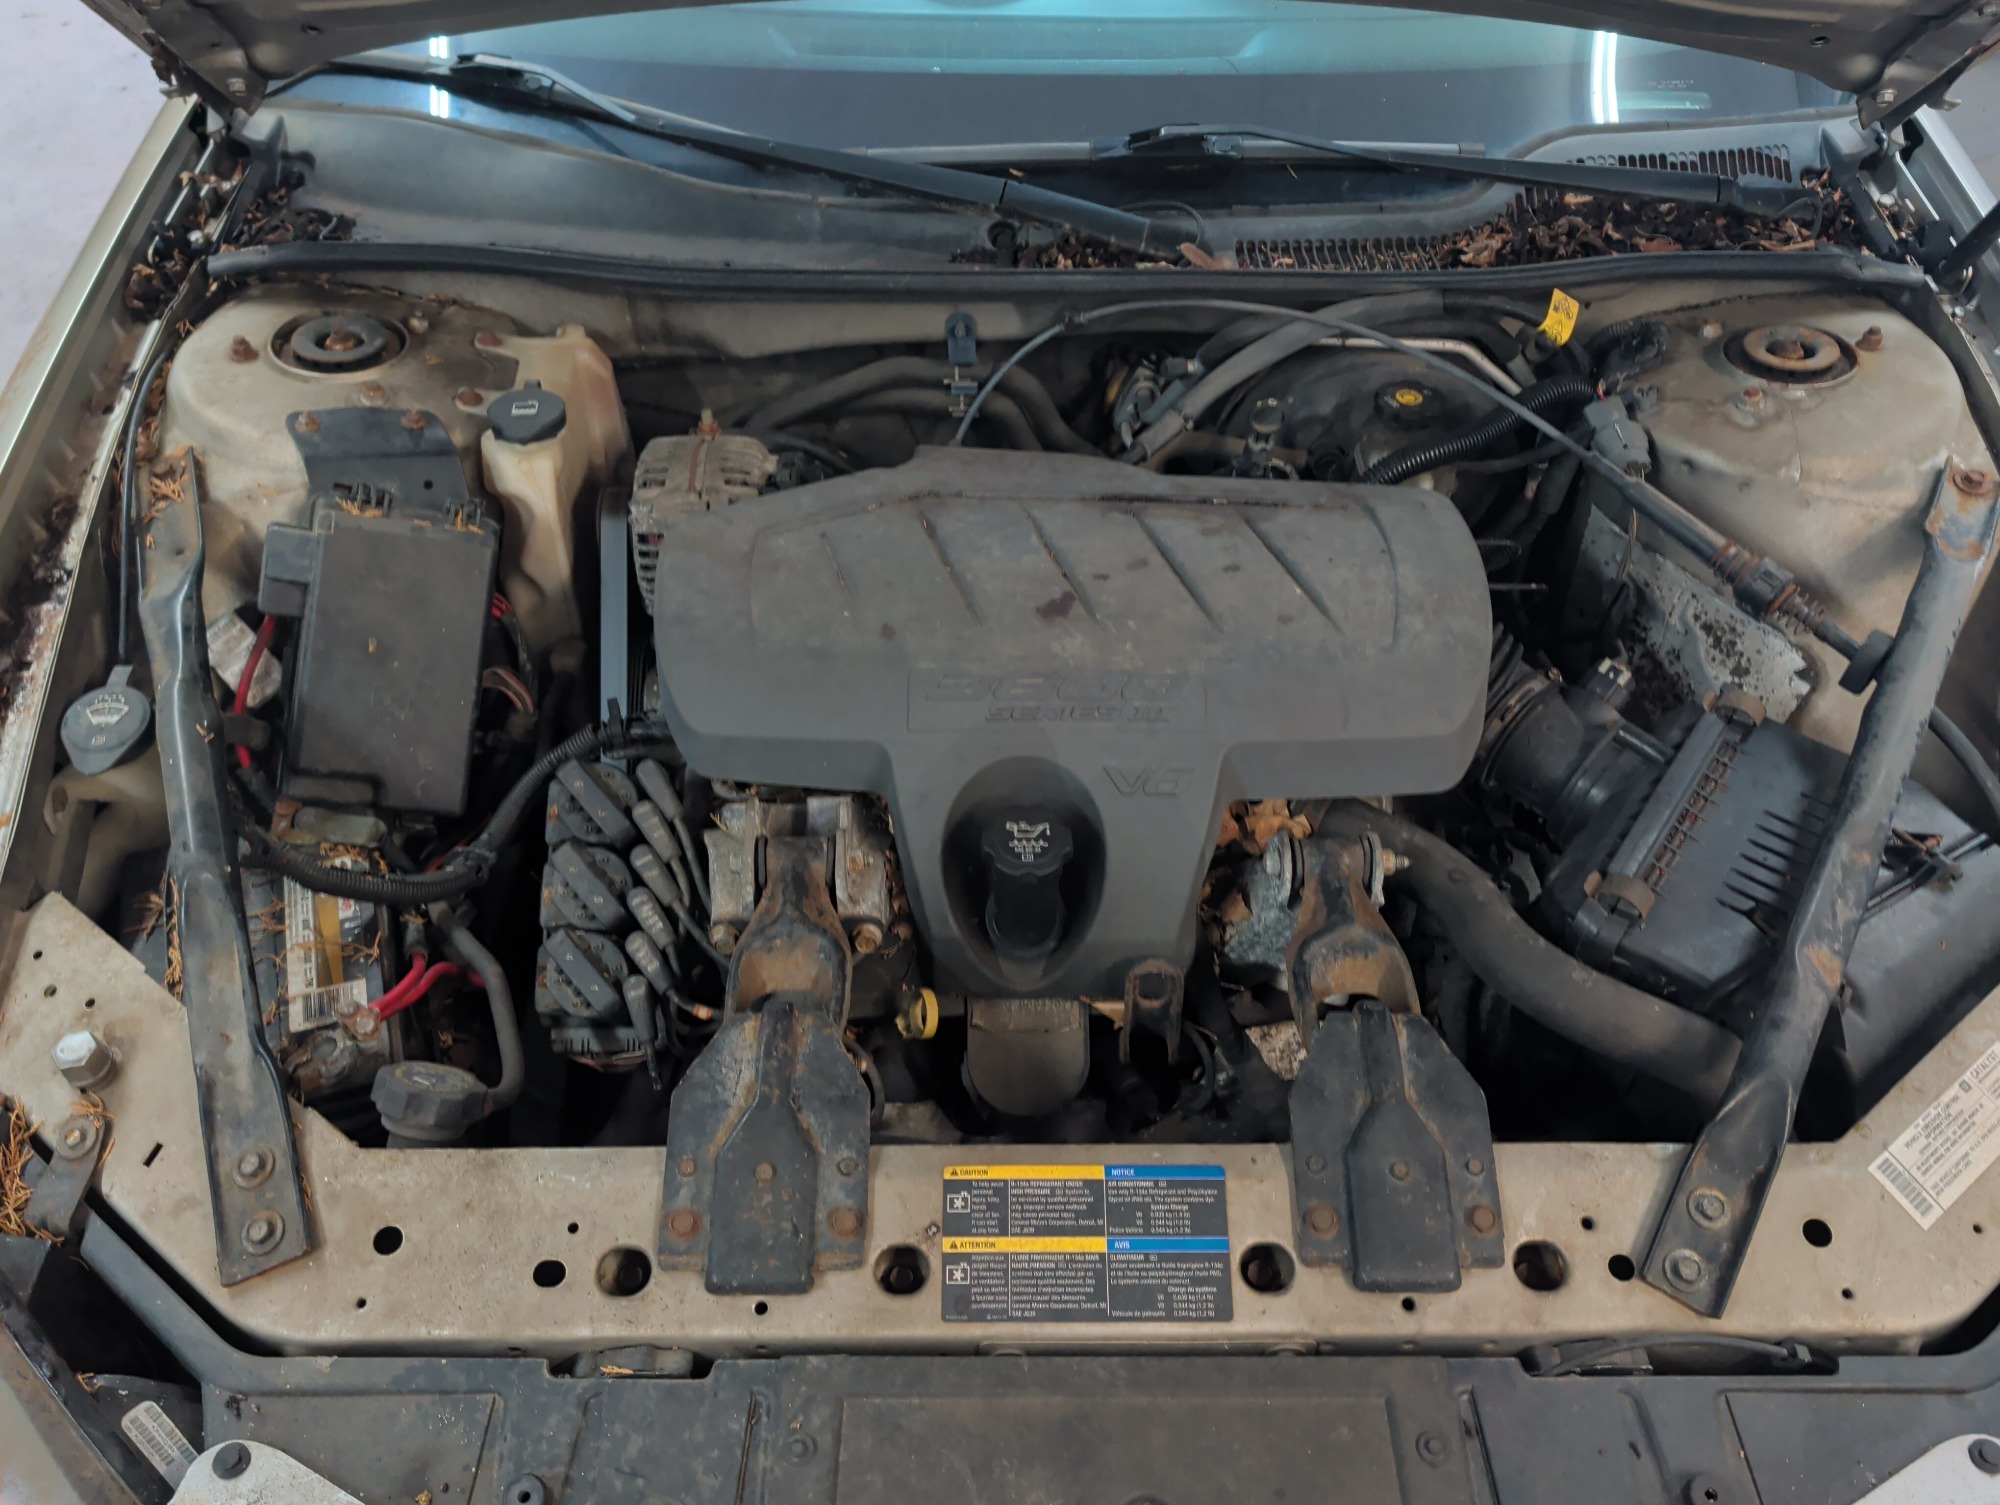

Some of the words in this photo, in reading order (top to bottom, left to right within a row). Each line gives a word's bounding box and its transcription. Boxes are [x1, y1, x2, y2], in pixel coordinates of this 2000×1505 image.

[985, 705, 1122, 721] SERIES
[1102, 765, 1195, 797] V6
[1970, 1050, 1999, 1080] CATALYST
[1112, 1168, 1135, 1176] NOTICE
[1114, 1241, 1130, 1249] AVIS
